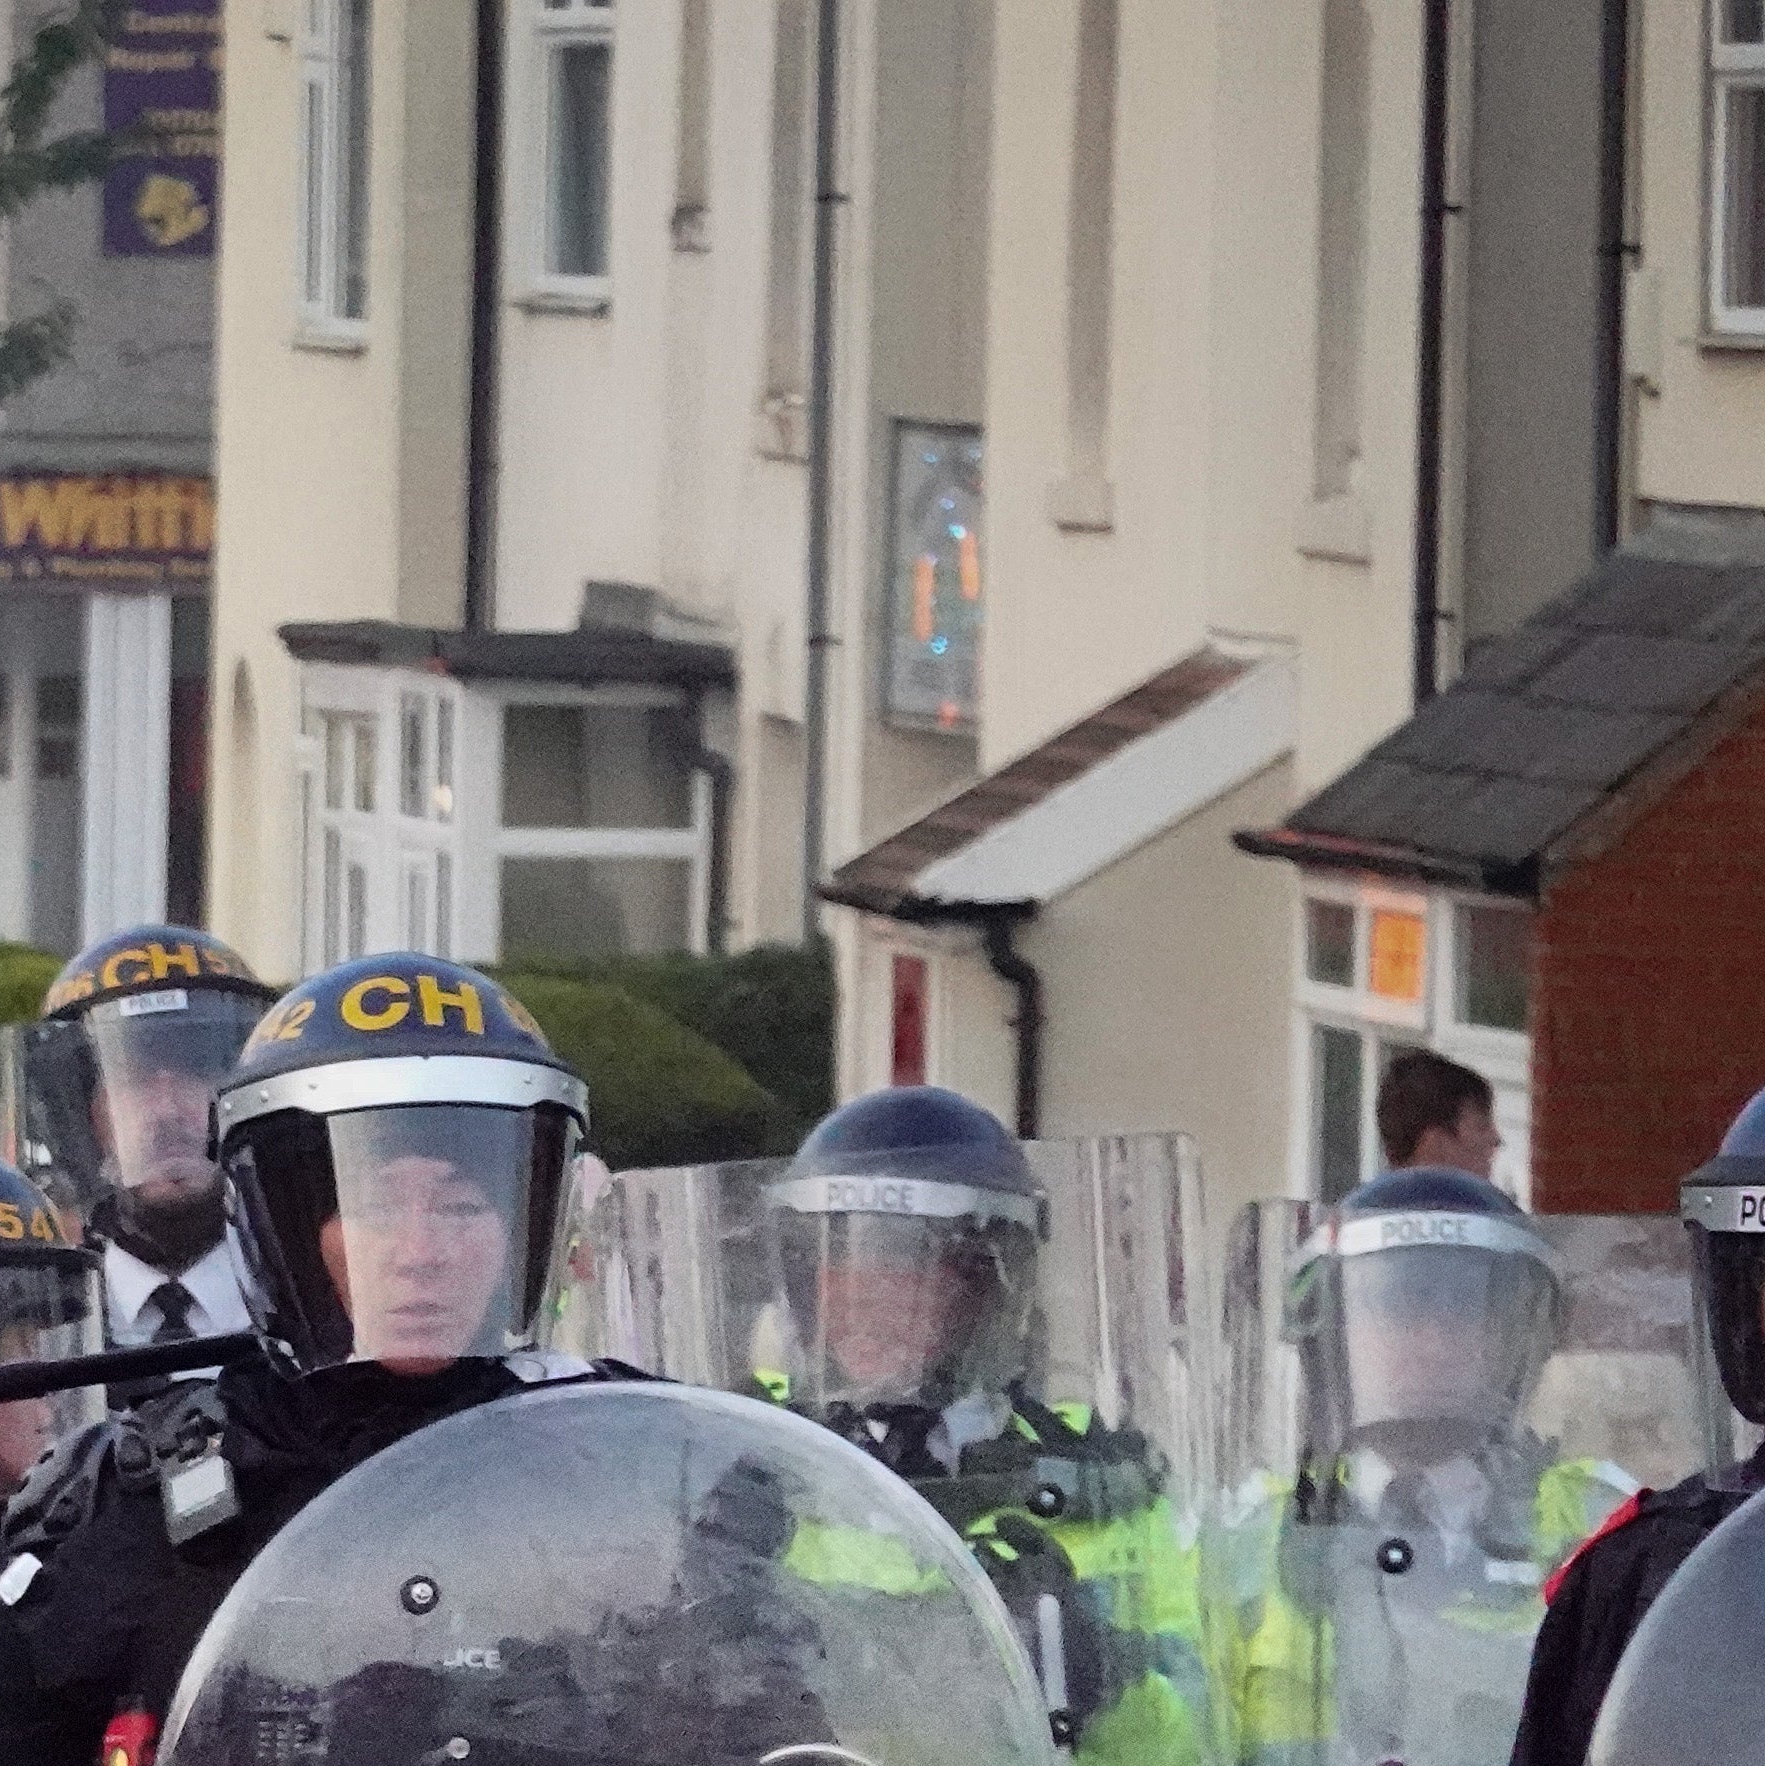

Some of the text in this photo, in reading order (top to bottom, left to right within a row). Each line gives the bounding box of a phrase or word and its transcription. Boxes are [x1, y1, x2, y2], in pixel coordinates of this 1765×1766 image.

[101, 942, 200, 988] CH
[341, 975, 484, 1034] CH
[828, 1182, 914, 1212] POLICE
[1381, 1217, 1469, 1245] POLICE
